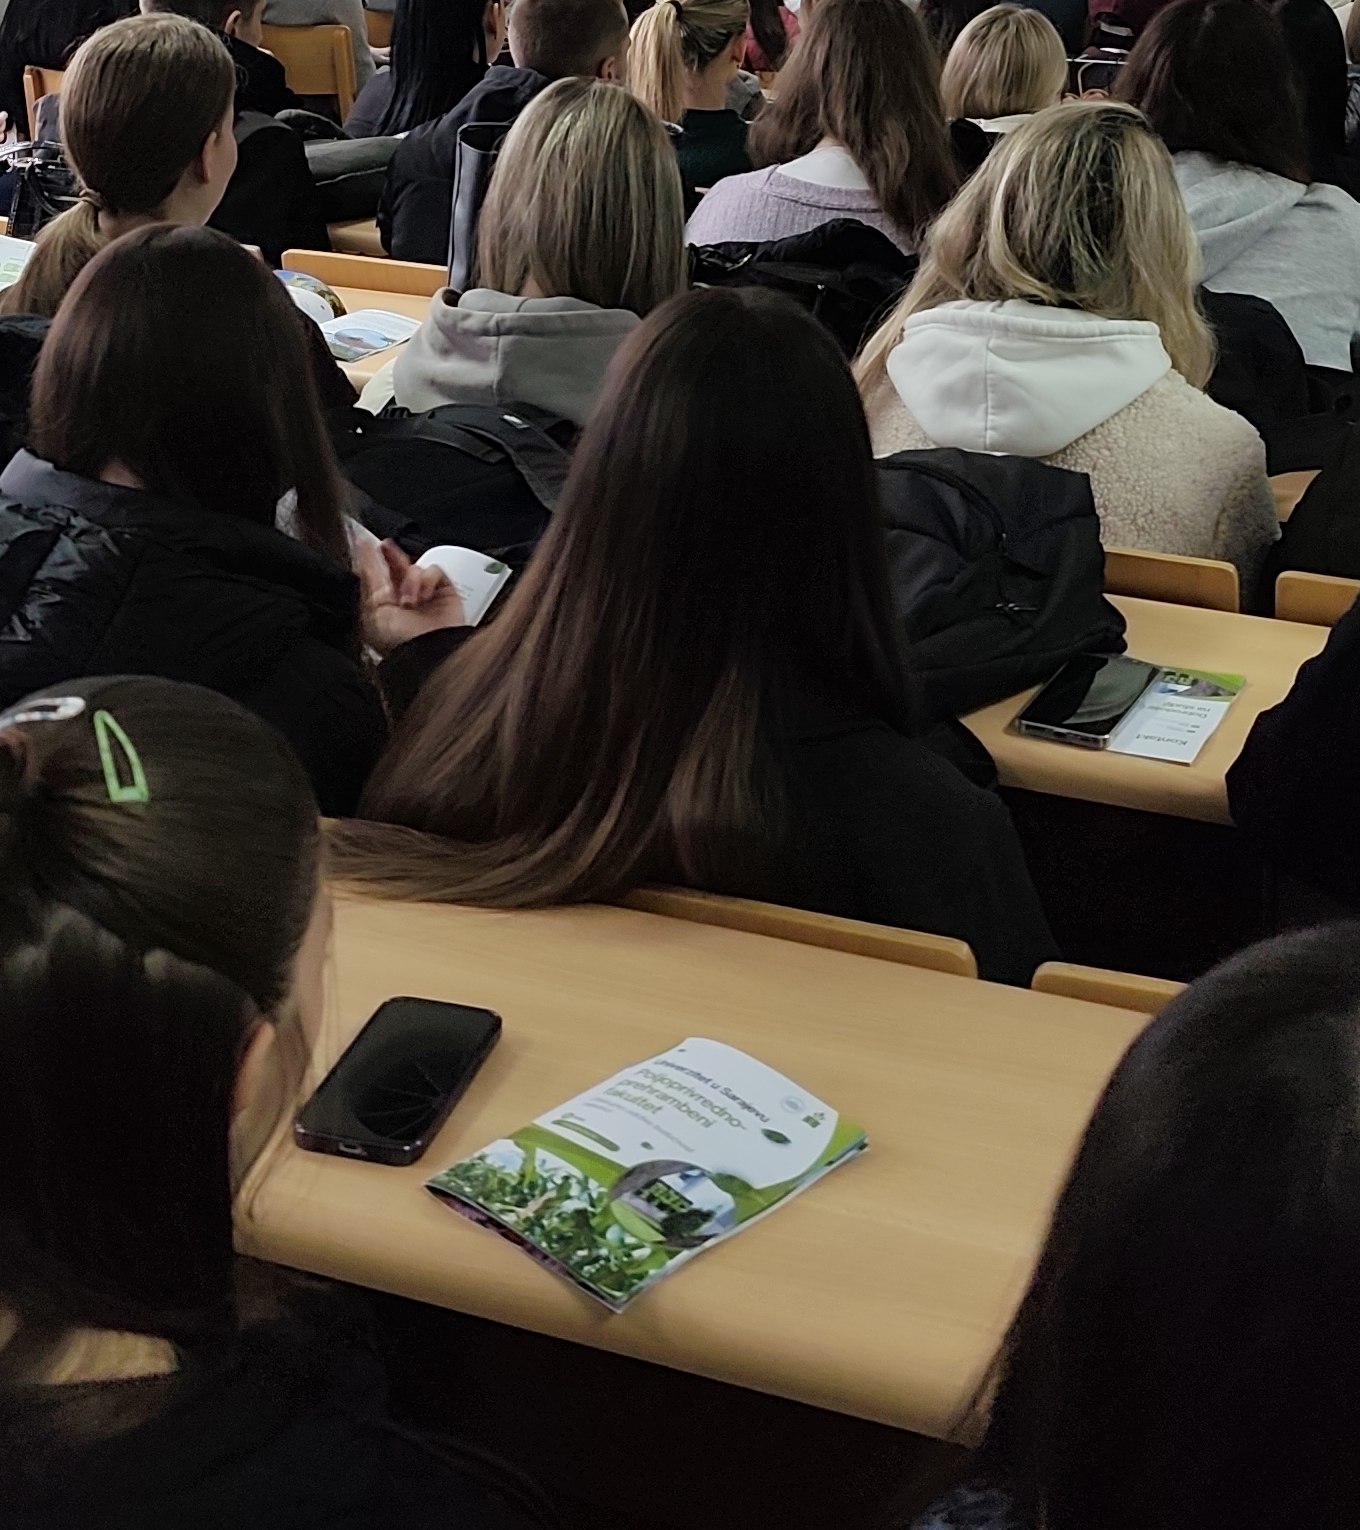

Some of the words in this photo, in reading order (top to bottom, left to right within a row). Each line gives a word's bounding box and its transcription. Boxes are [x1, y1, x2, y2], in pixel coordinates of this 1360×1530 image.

[1136, 733, 1188, 746] Kontakt
[602, 1086, 665, 1116] fakultet
[616, 1077, 717, 1129] prehrambeni
[635, 1068, 748, 1130] Poljoprivredno-
[653, 1057, 713, 1086] Univerzitet
[720, 1086, 771, 1123] Sarajevu
